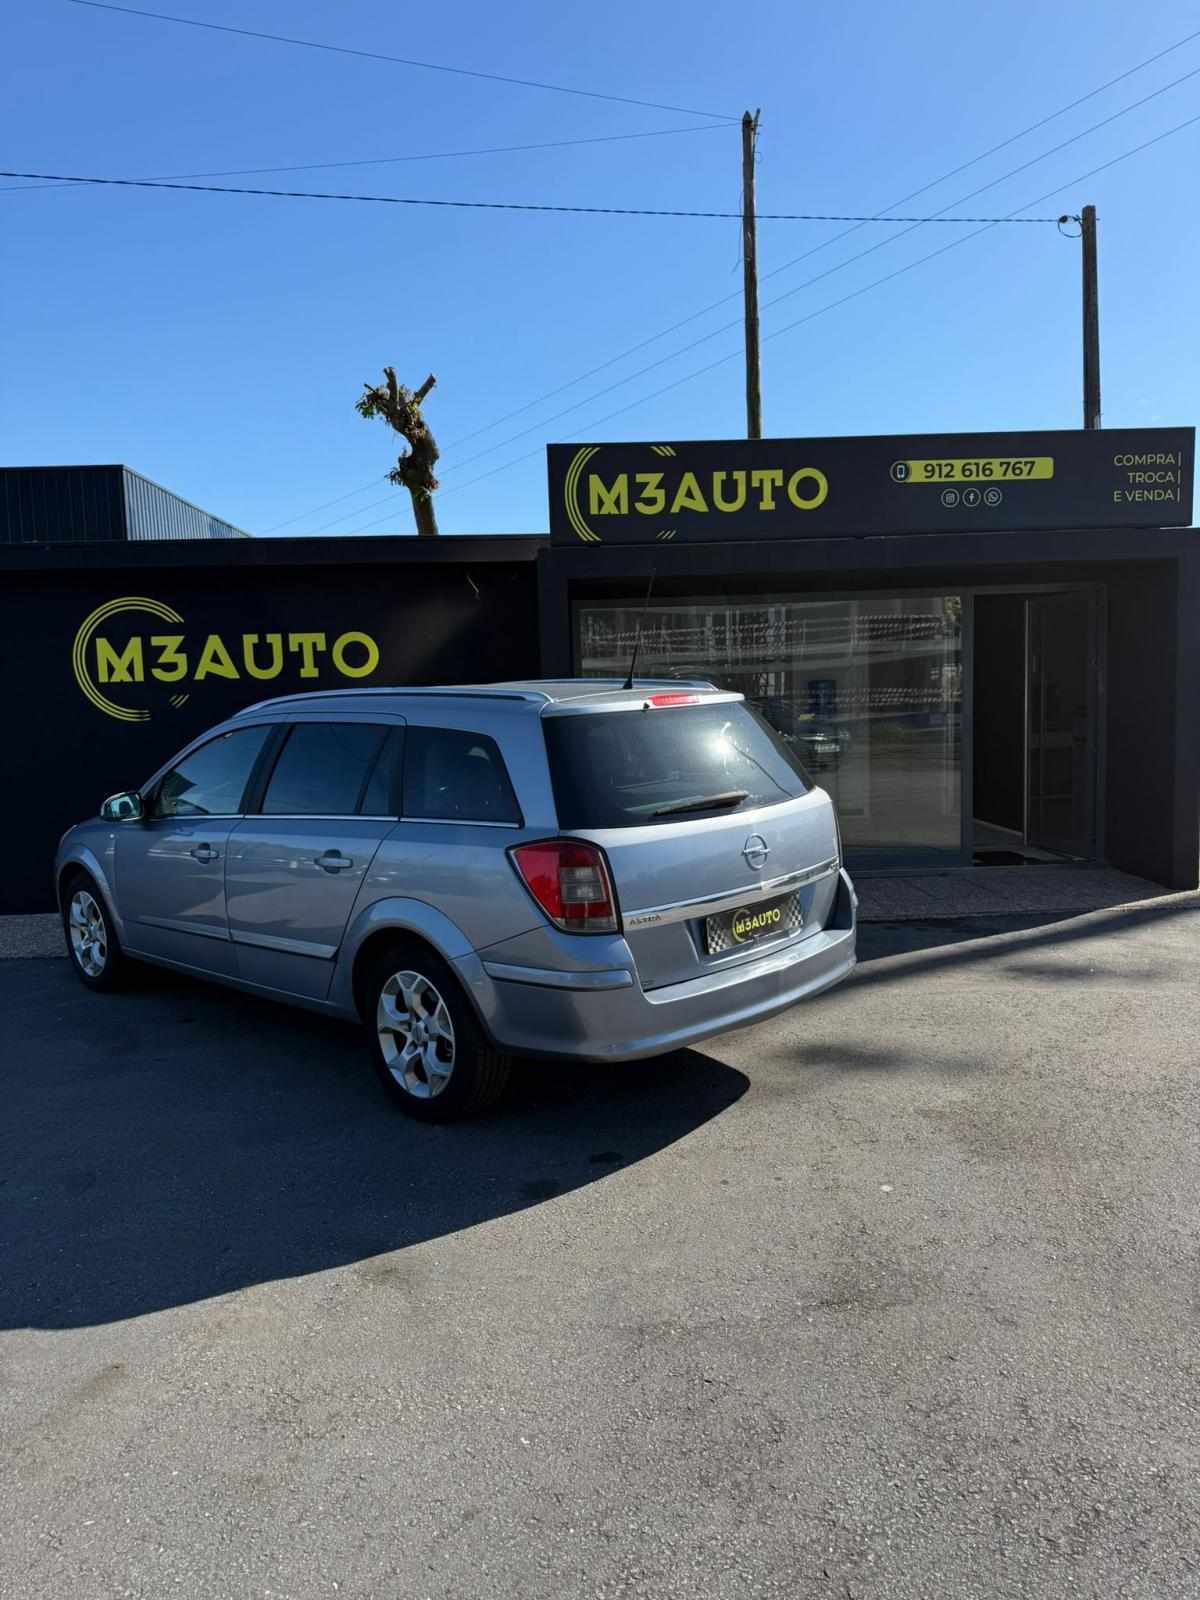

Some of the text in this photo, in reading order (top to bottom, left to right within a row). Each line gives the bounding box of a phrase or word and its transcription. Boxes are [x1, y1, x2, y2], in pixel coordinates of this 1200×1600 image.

[1113, 454, 1175, 466] COMPRA
[924, 461, 1035, 478] 912 616 767
[1128, 472, 1174, 484] TROCA
[588, 467, 829, 515] M3AUTO
[1113, 489, 1174, 502] E VENDA
[95, 631, 380, 683] M3AUTO
[735, 908, 780, 934] M3AUTO
